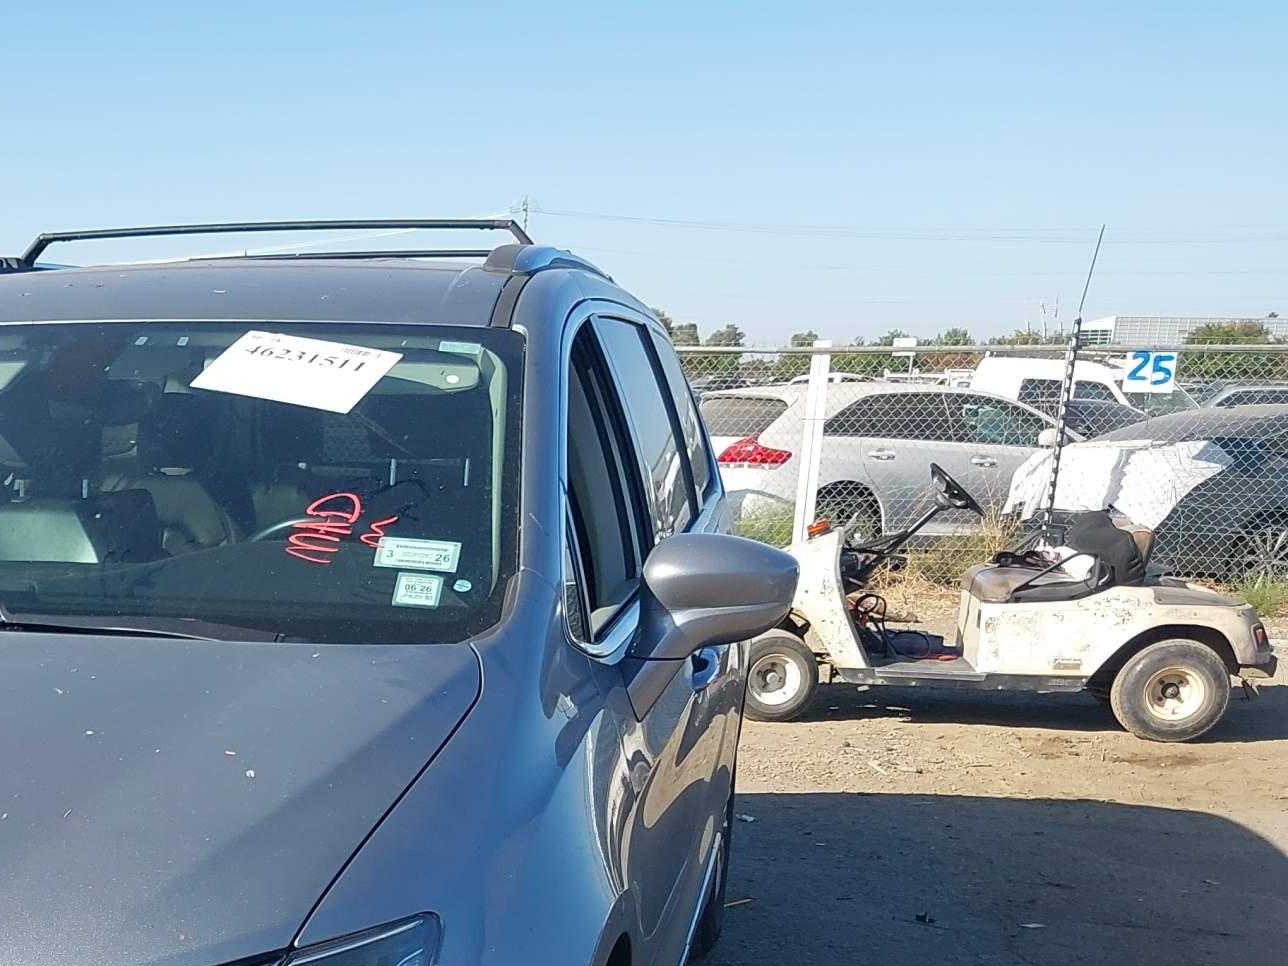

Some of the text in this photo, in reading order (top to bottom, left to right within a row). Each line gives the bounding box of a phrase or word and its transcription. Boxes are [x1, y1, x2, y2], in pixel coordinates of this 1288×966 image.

[244, 344, 366, 372] 46231511
[1127, 350, 1175, 386] 25
[433, 552, 451, 564] 26
